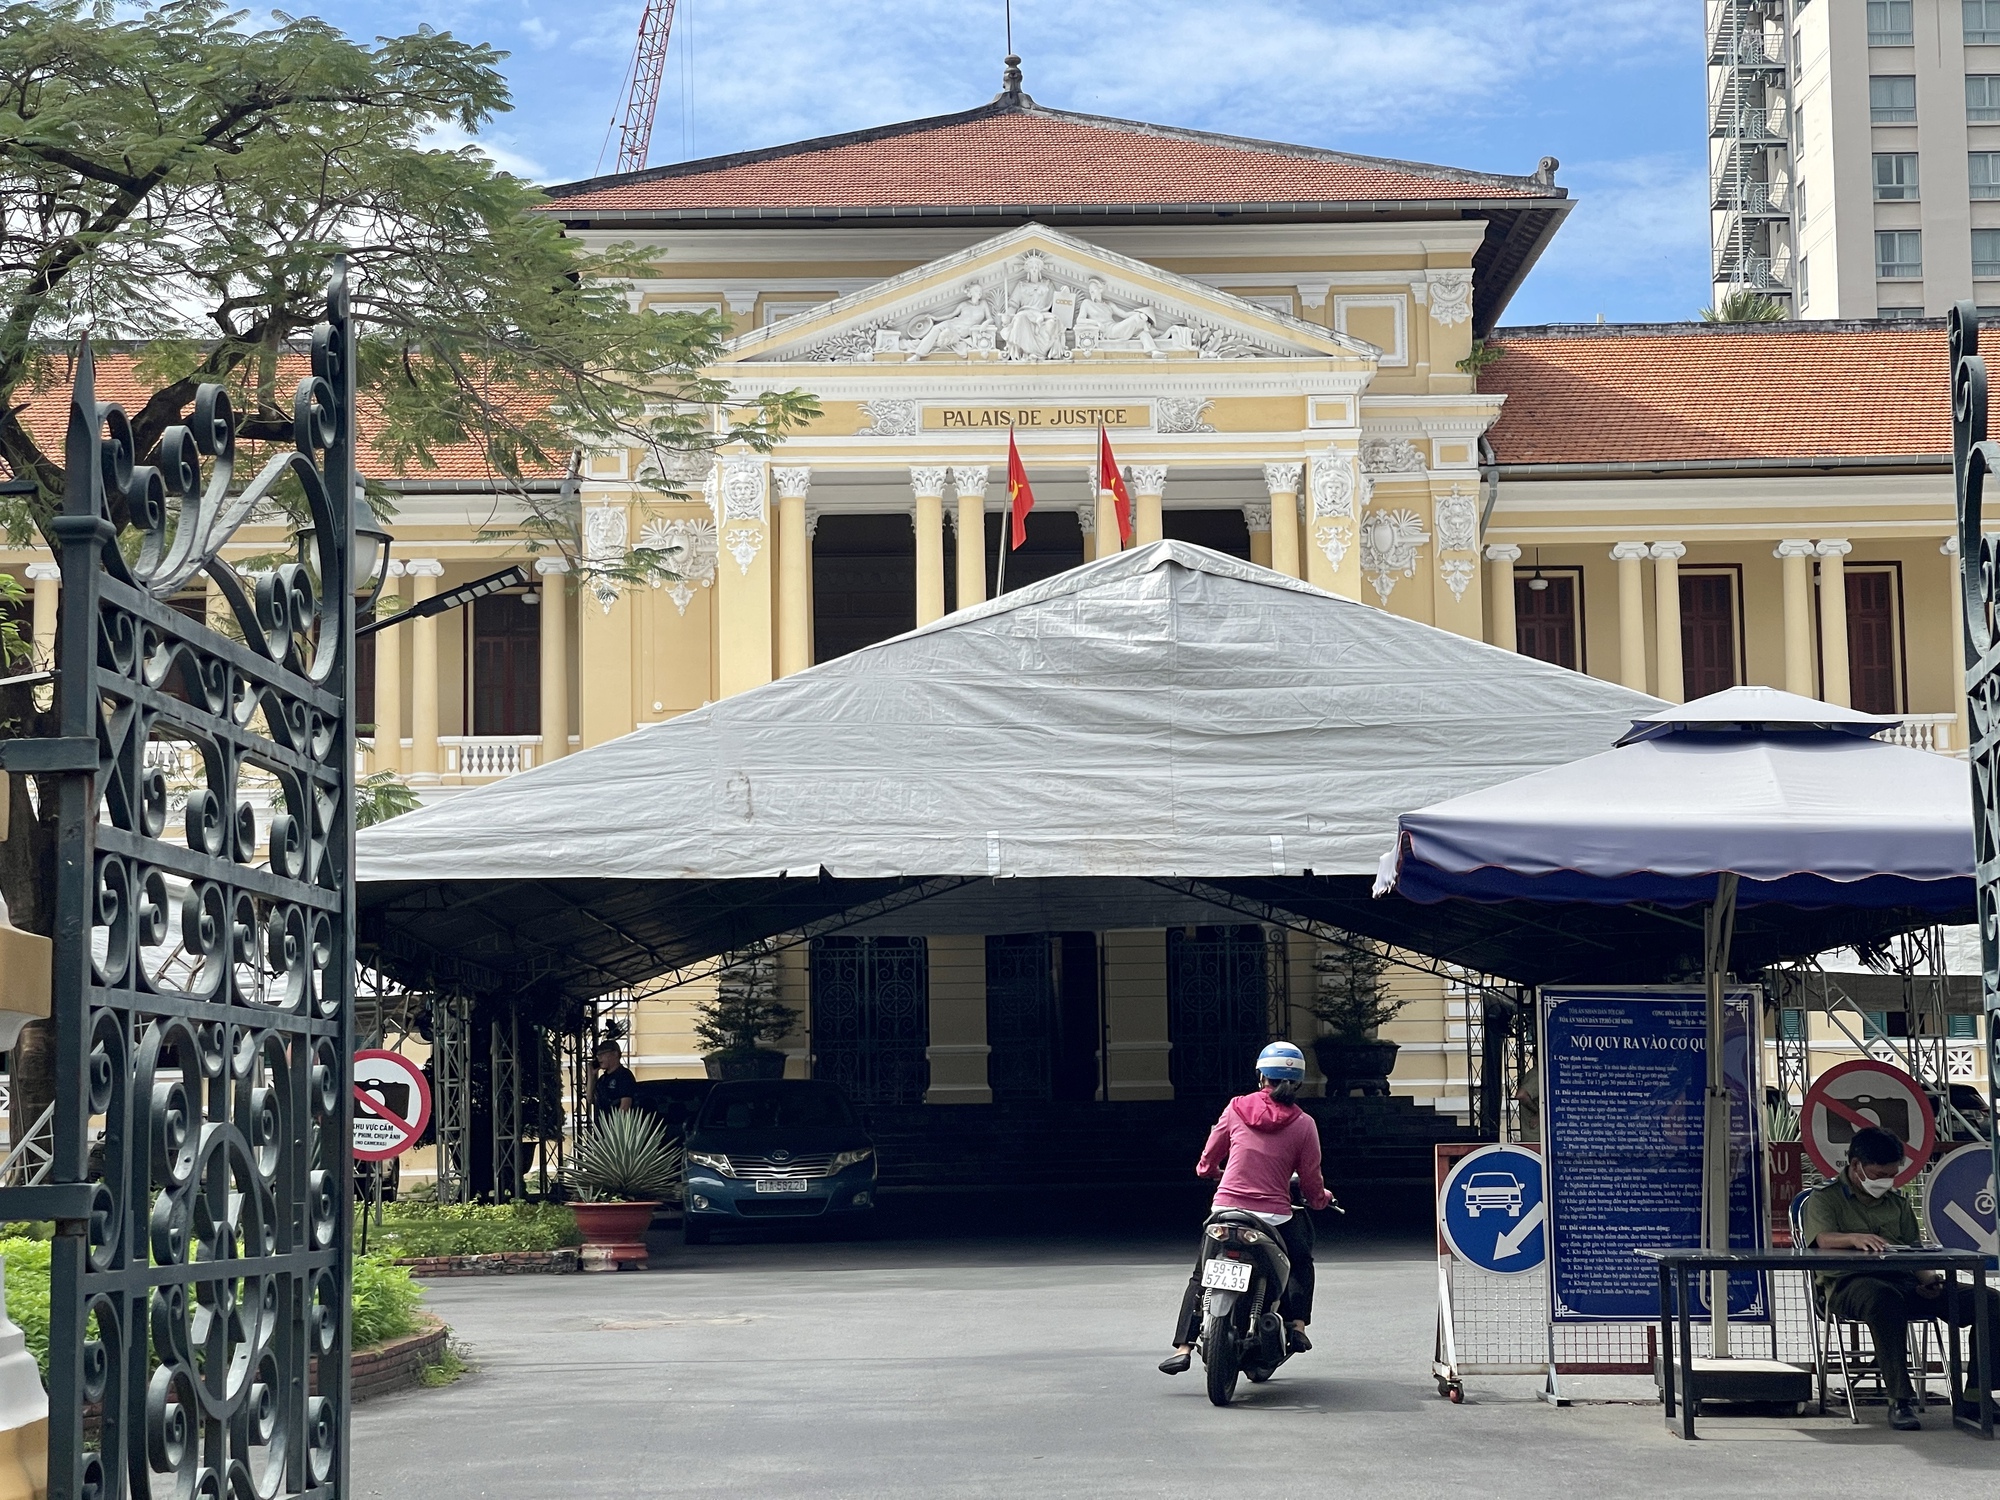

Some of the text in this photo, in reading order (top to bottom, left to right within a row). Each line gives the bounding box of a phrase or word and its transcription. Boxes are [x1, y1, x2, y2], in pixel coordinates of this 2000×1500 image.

[943, 410, 1011, 426] PALAIS
[1018, 410, 1041, 425] DE
[1571, 1034, 1707, 1052] NỘI QUY RA VÀO CƠ QU
[366, 1123, 379, 1131] VỰC
[379, 1122, 394, 1131] CẤM
[1206, 1273, 1246, 1290] 574.35
